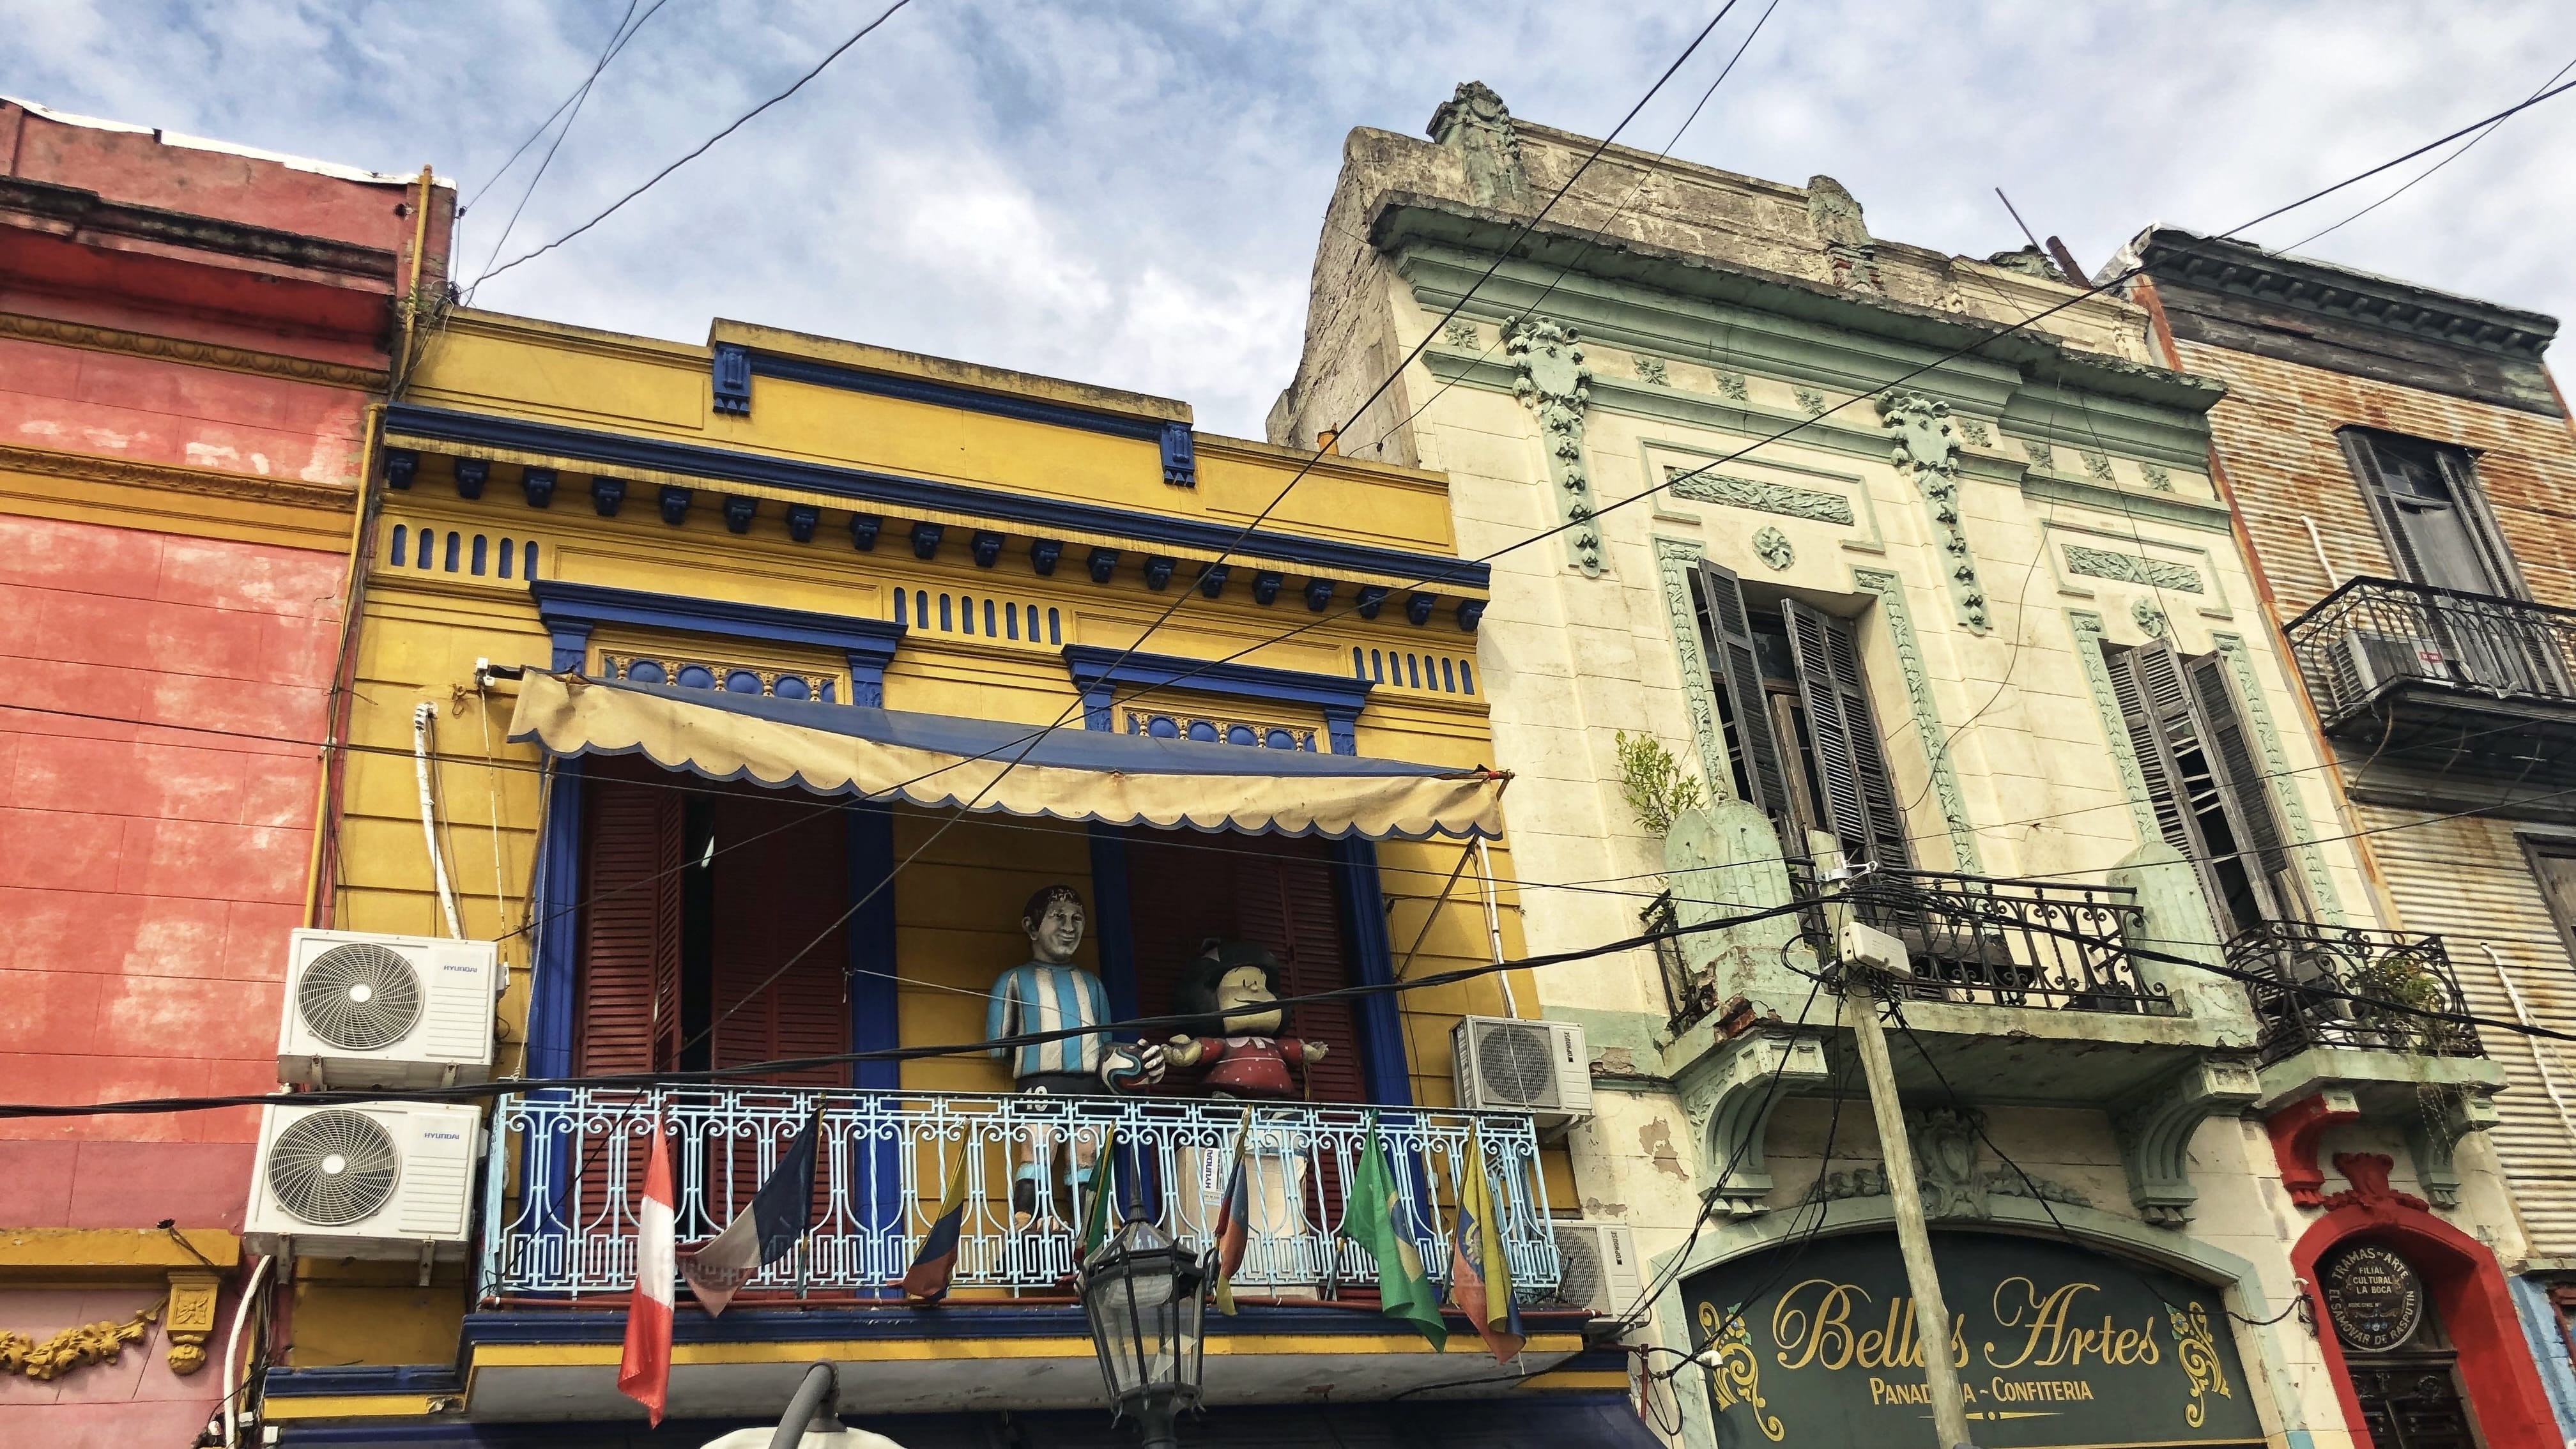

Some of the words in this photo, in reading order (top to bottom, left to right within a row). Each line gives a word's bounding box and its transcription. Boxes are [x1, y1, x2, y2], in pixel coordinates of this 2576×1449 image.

[1563, 1031, 1574, 1062] TOPHOUSE
[1205, 1149, 1213, 1188] HYUNDAI
[1610, 1230, 1623, 1265] TOPHOUSE
[2332, 1247, 2375, 1279] TRAMAS
[2383, 1252, 2409, 1280] ARTE
[2329, 1289, 2341, 1301] EL
[2356, 1286, 2368, 1294] LA
[2371, 1285, 2392, 1294] BOCA
[1772, 1278, 1970, 1370] Bells
[1984, 1276, 2159, 1369] Artes
[2331, 1303, 2372, 1345] SAMOVAR
[2390, 1291, 2415, 1340] RASPUTIN
[2374, 1334, 2388, 1345] DE
[1869, 1377, 1977, 1406] PANADA
[1992, 1376, 2095, 1402] CONFITERIA
